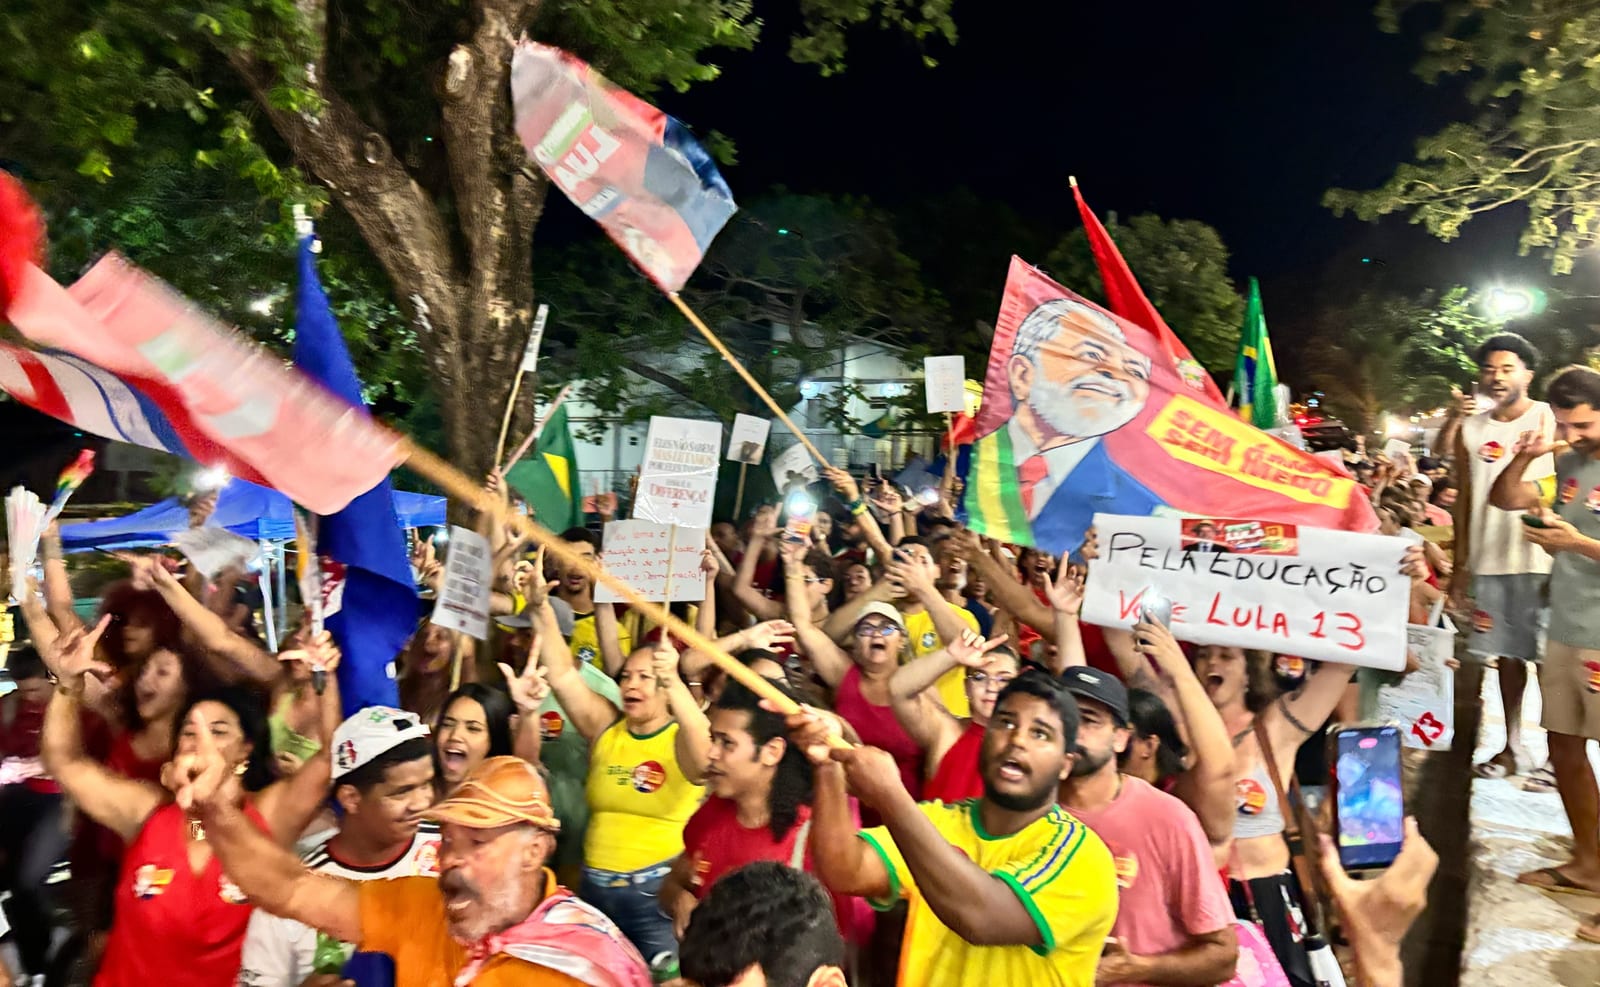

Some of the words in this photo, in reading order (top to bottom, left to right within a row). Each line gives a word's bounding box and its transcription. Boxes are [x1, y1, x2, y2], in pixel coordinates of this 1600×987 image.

[1168, 409, 1238, 452] SEM
[650, 483, 708, 504] DIFERENÇA!
[1239, 460, 1334, 498] MEDO
[1108, 532, 1196, 574] PELA
[1209, 550, 1387, 595] EDUCAÇÃO
[1119, 586, 1188, 623] VOE
[1207, 591, 1289, 638] LULA
[1309, 611, 1366, 651] 13
[1411, 711, 1445, 747] 13
